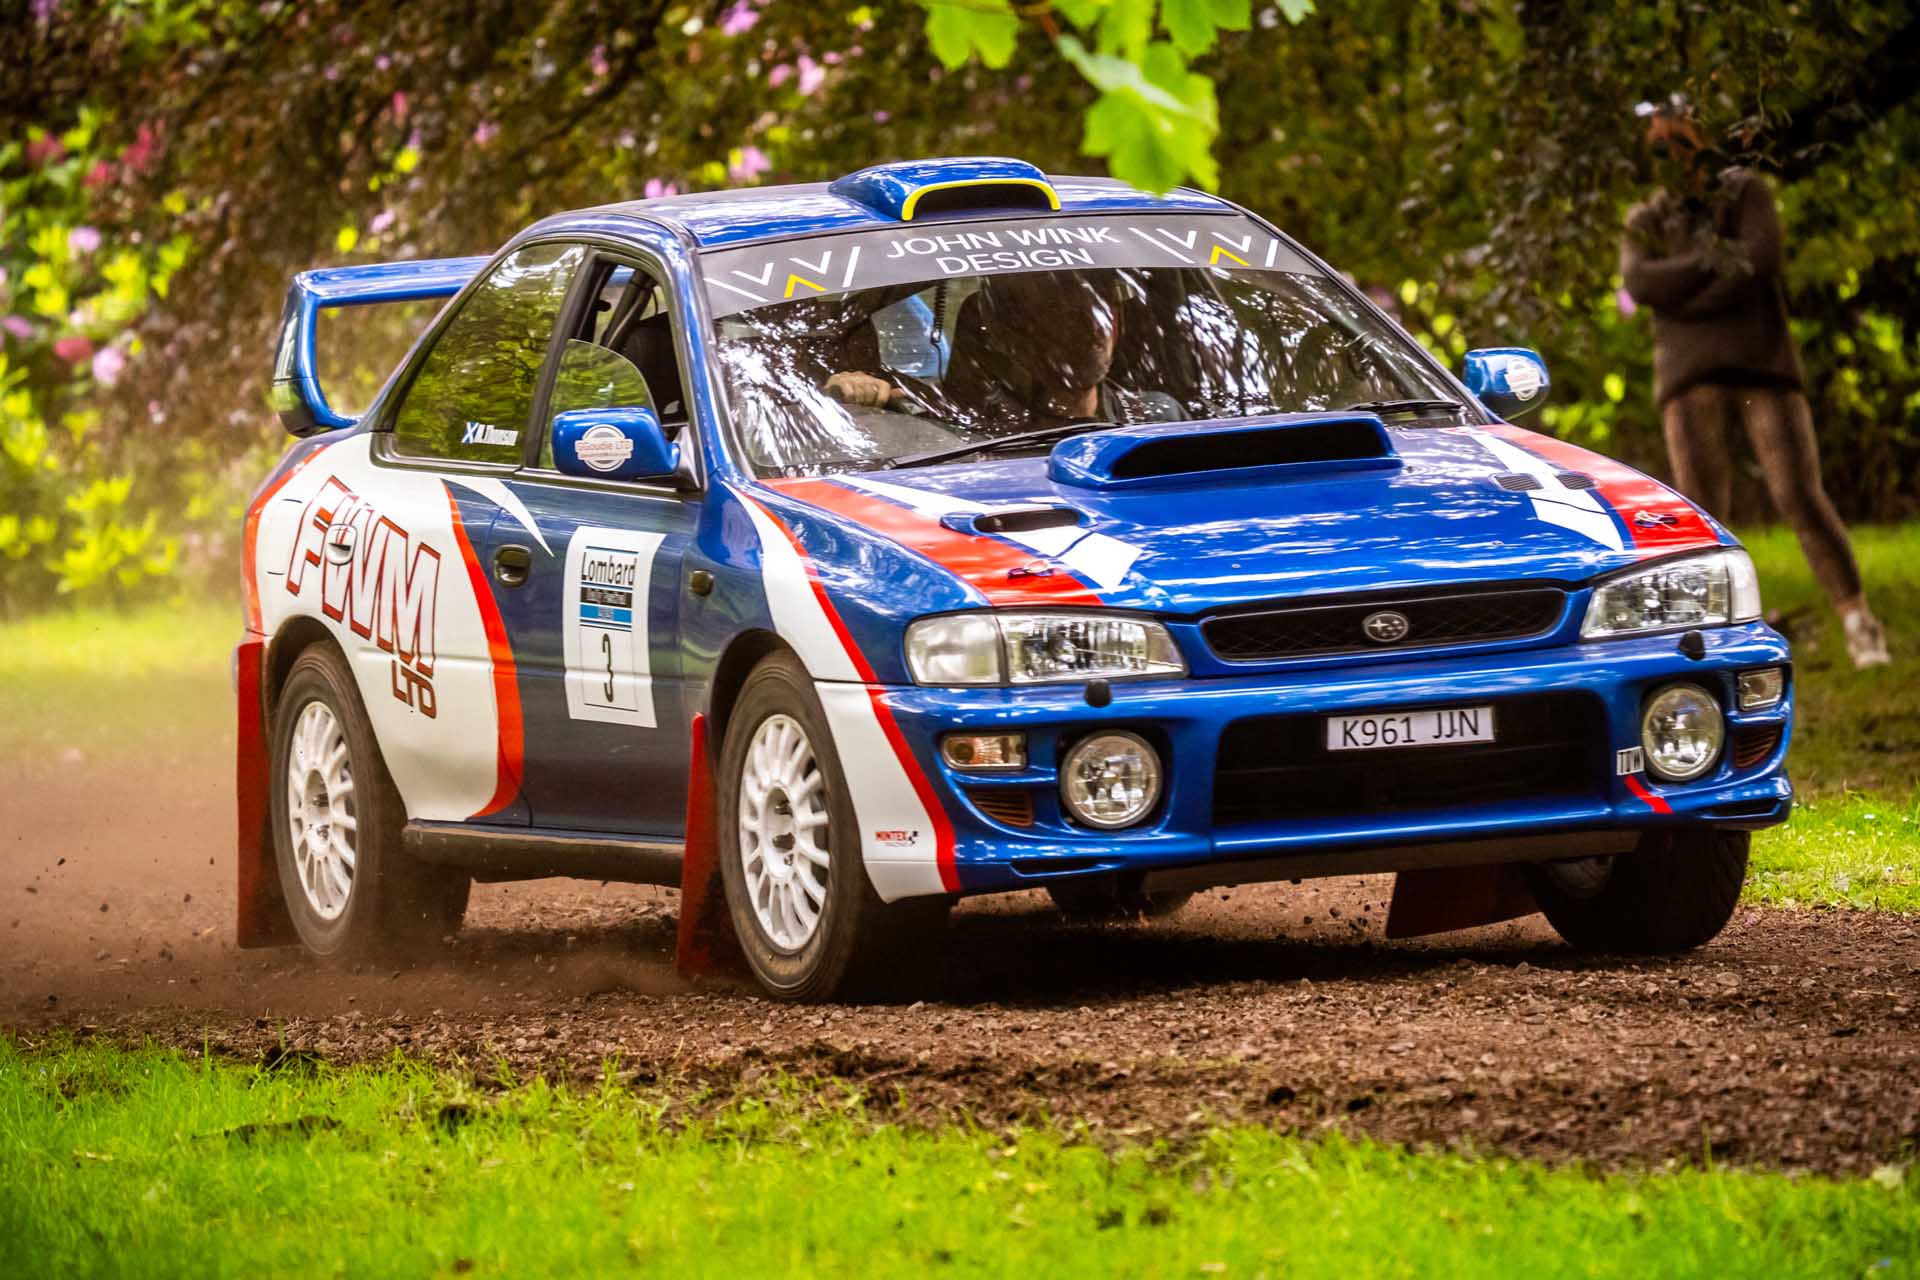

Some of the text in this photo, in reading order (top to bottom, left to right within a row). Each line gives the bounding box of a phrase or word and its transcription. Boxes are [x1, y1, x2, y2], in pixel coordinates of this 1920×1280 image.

[888, 228, 1120, 258] JOHN WINK
[936, 248, 1095, 275] DESIGN
[581, 552, 638, 586] Lombard
[602, 633, 614, 703] 3
[391, 658, 437, 719] LTD
[1342, 709, 1480, 747] K961 JJN
